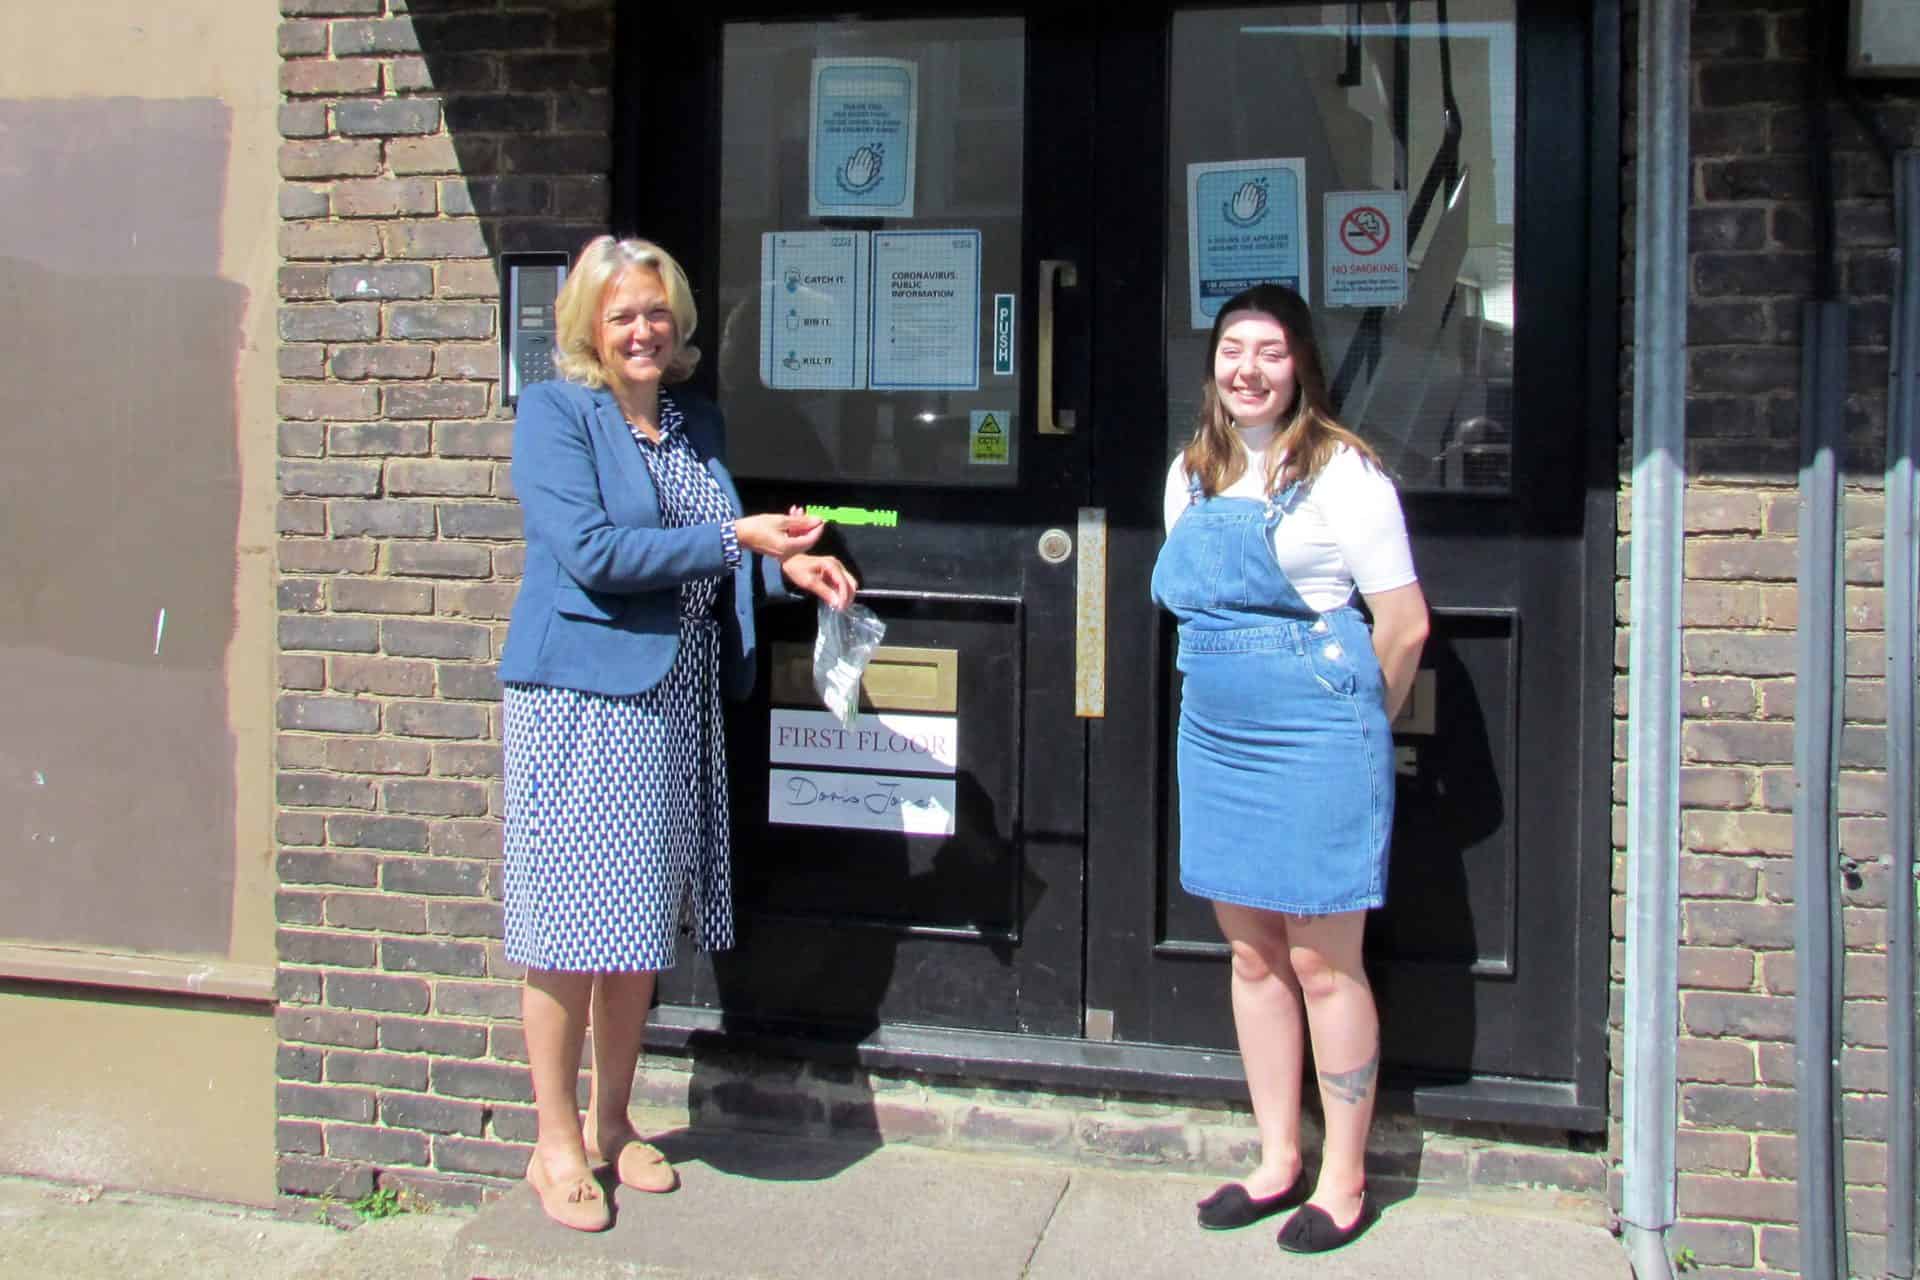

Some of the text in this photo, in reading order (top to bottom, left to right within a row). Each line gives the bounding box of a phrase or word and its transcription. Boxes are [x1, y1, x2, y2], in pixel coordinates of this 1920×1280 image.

[1331, 263, 1400, 274] NO SMOKING
[804, 275, 834, 284] CATCH
[891, 281, 922, 289] PUBLIC
[891, 289, 955, 298] INFORMATION
[999, 307, 1009, 362] PUSH
[777, 726, 948, 754] FIRST FLOOR
[786, 776, 860, 806] Doris
